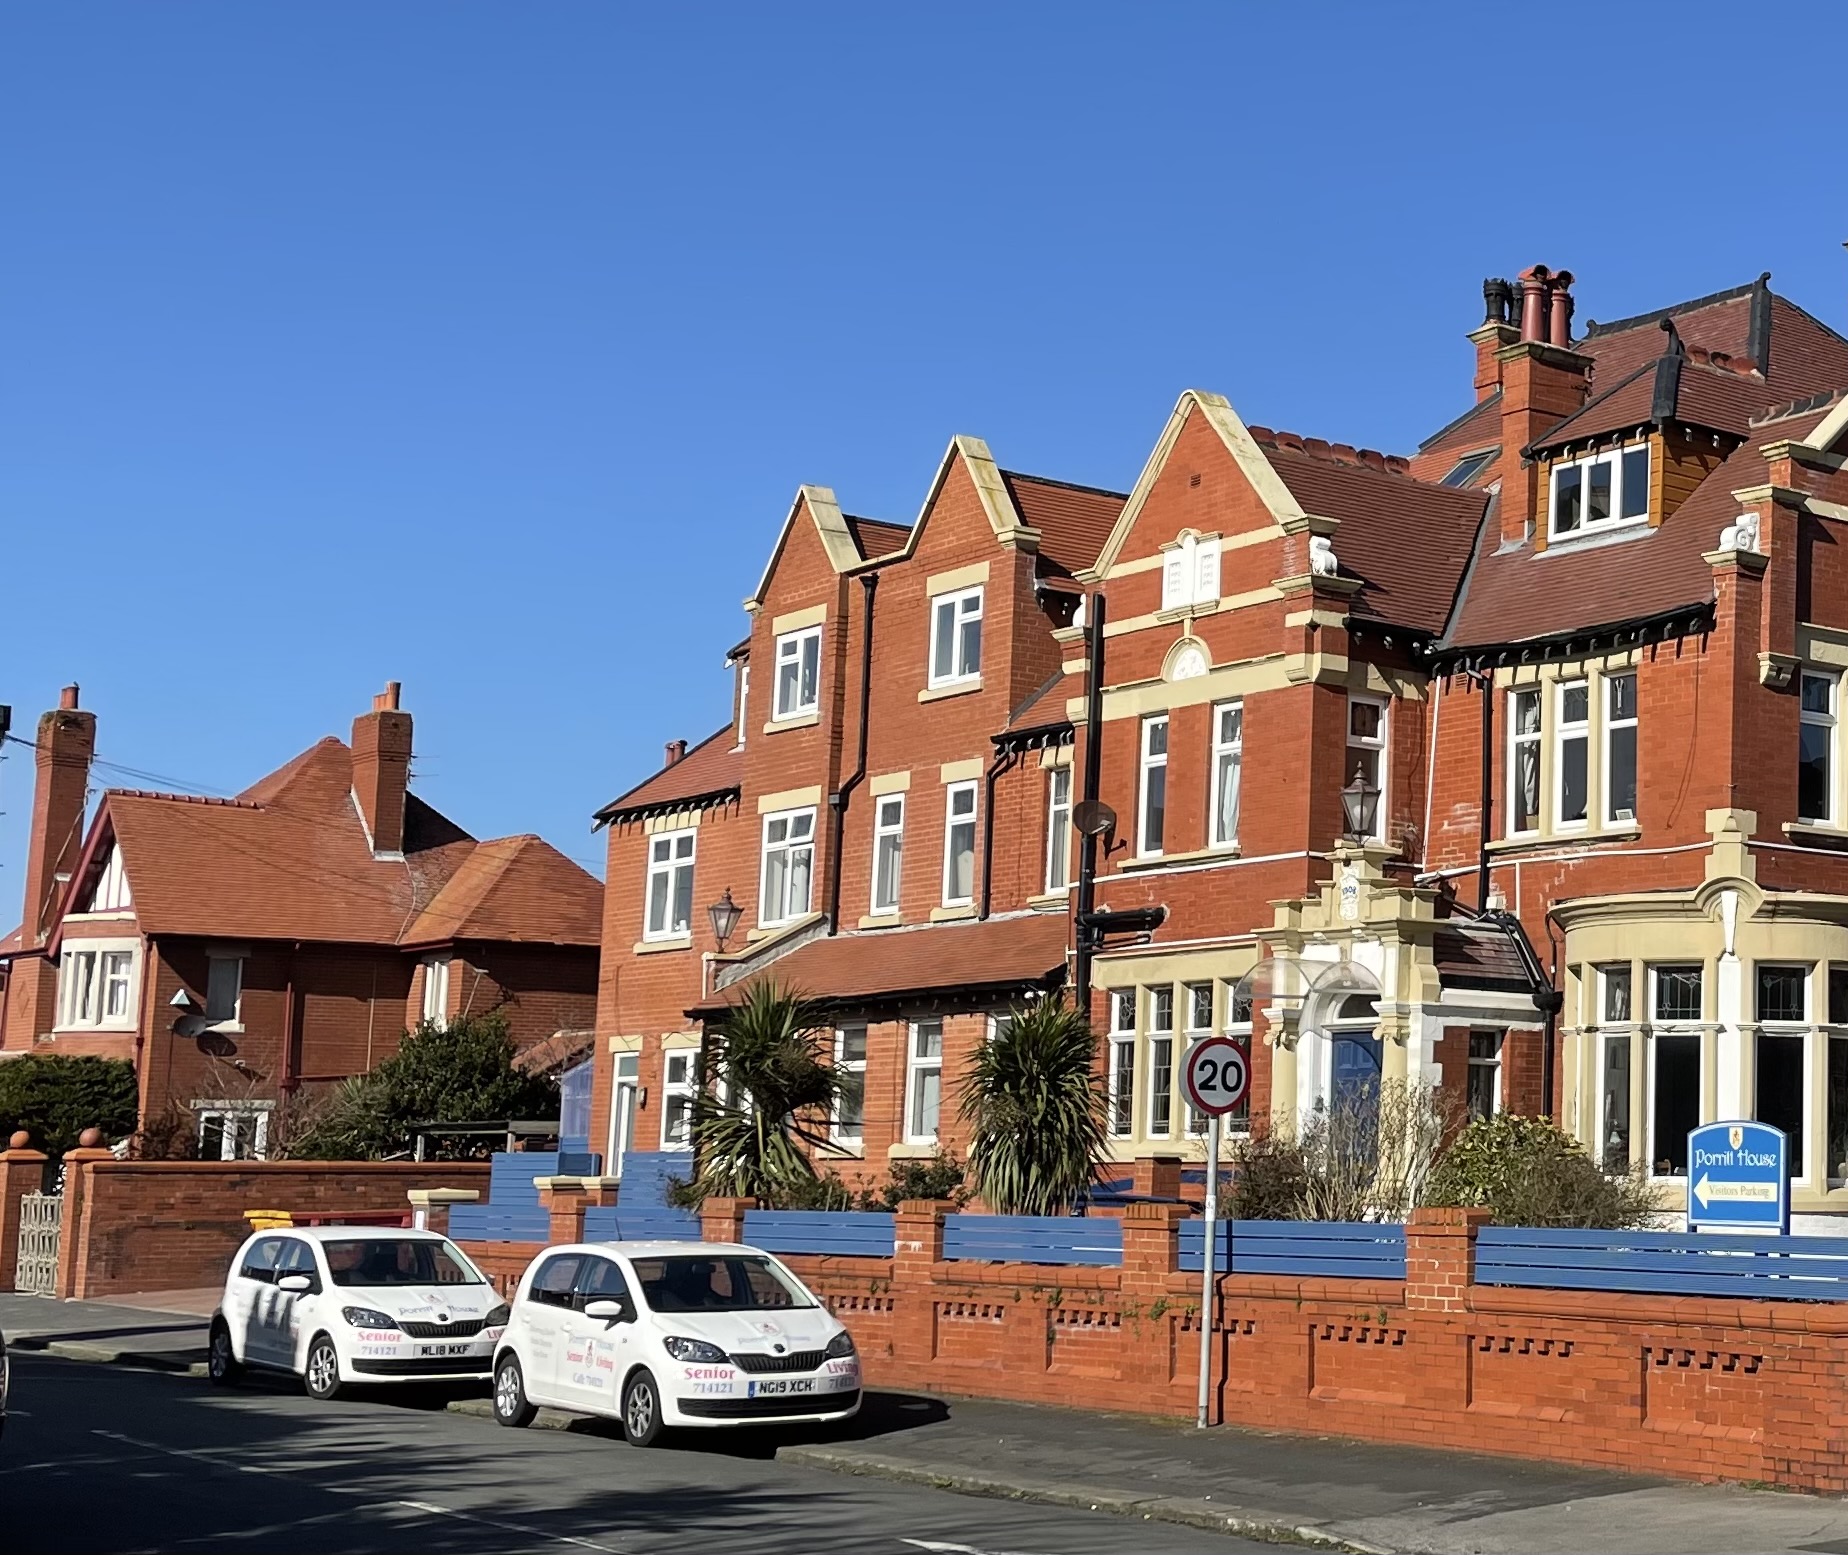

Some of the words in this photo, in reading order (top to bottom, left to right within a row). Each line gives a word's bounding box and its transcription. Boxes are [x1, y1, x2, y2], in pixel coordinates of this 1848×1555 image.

[1198, 1059, 1243, 1093] 20
[1737, 1149, 1777, 1168] House
[1709, 1185, 1738, 1196] Visitors
[1740, 1186, 1770, 1199] Parking
[357, 1330, 402, 1343] Senior
[361, 1345, 397, 1355] 714121
[684, 1366, 736, 1380] Senior
[826, 1361, 859, 1376] Living
[693, 1382, 734, 1394] 714121
[759, 1380, 786, 1394] NG19
[789, 1380, 813, 1392] XCH
